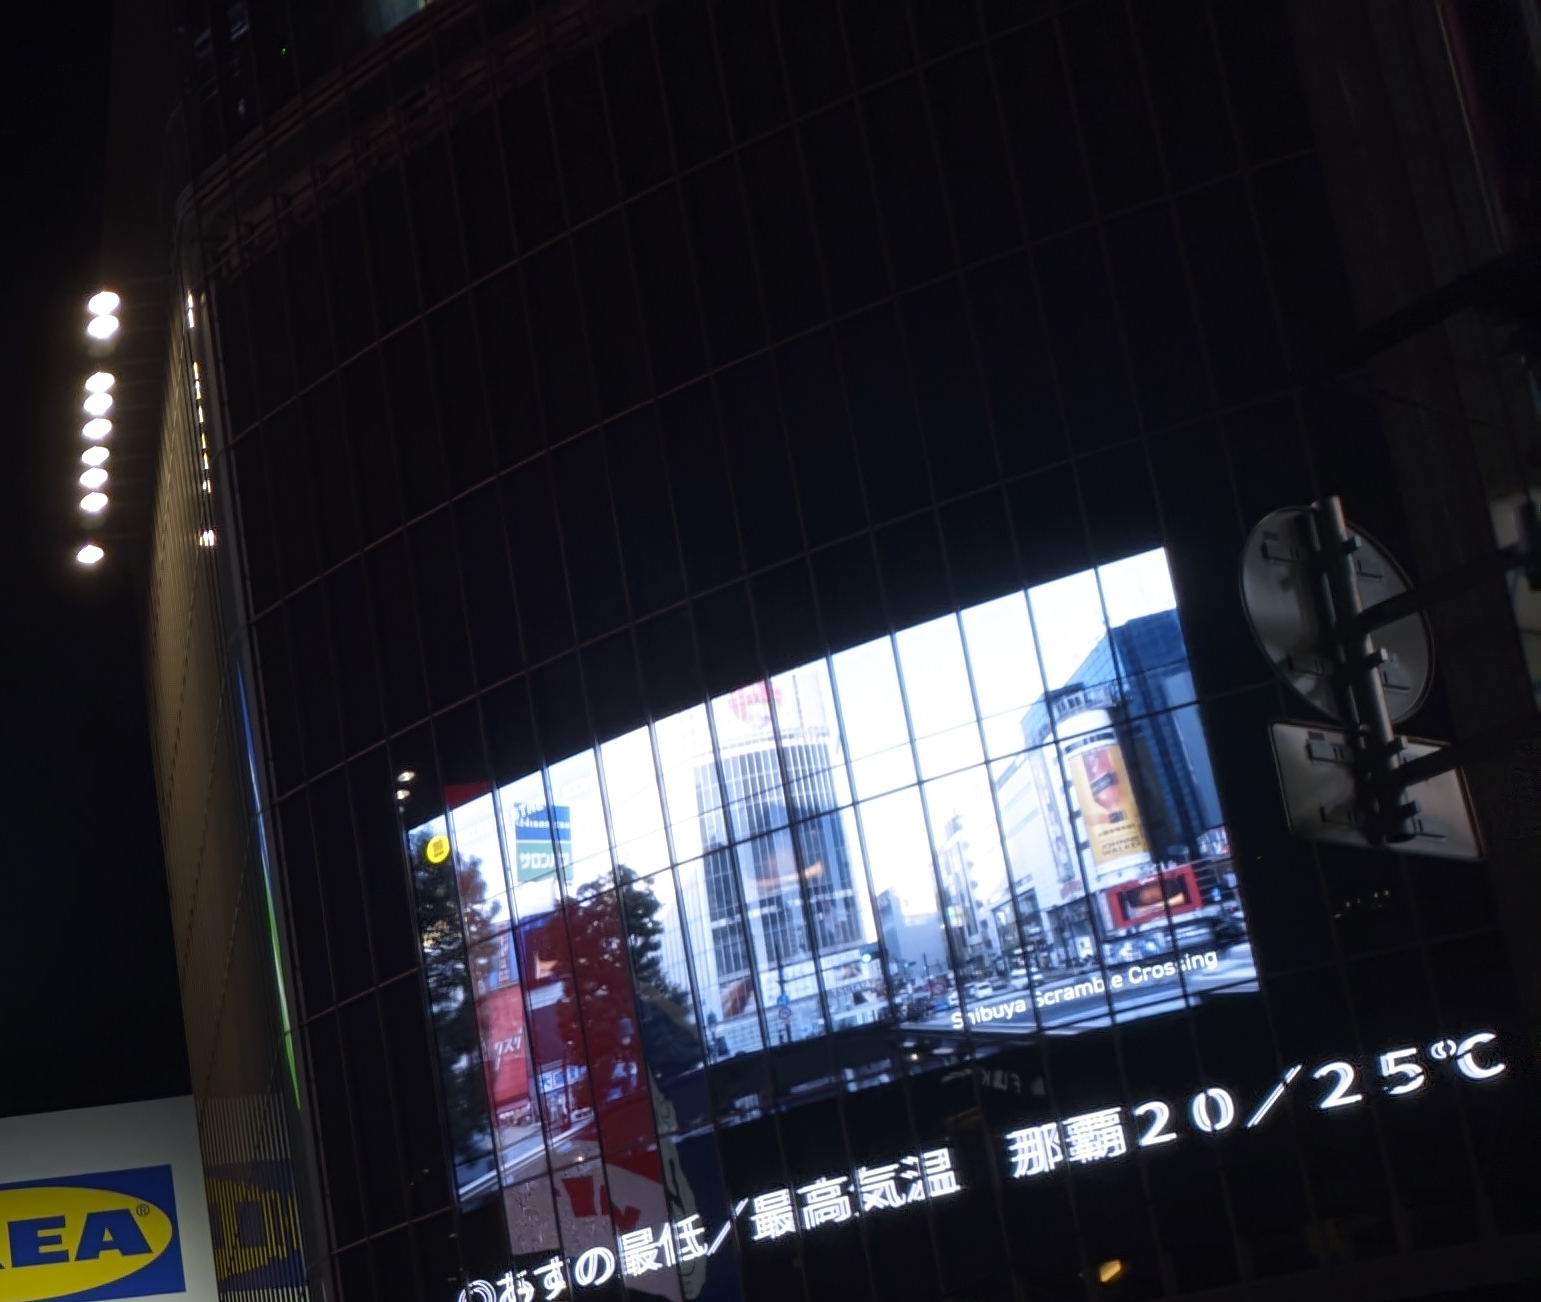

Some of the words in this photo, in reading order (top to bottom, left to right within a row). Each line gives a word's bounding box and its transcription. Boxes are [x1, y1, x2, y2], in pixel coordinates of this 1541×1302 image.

[520, 851, 570, 870] サロンス
[1036, 973, 1123, 1007] crambe
